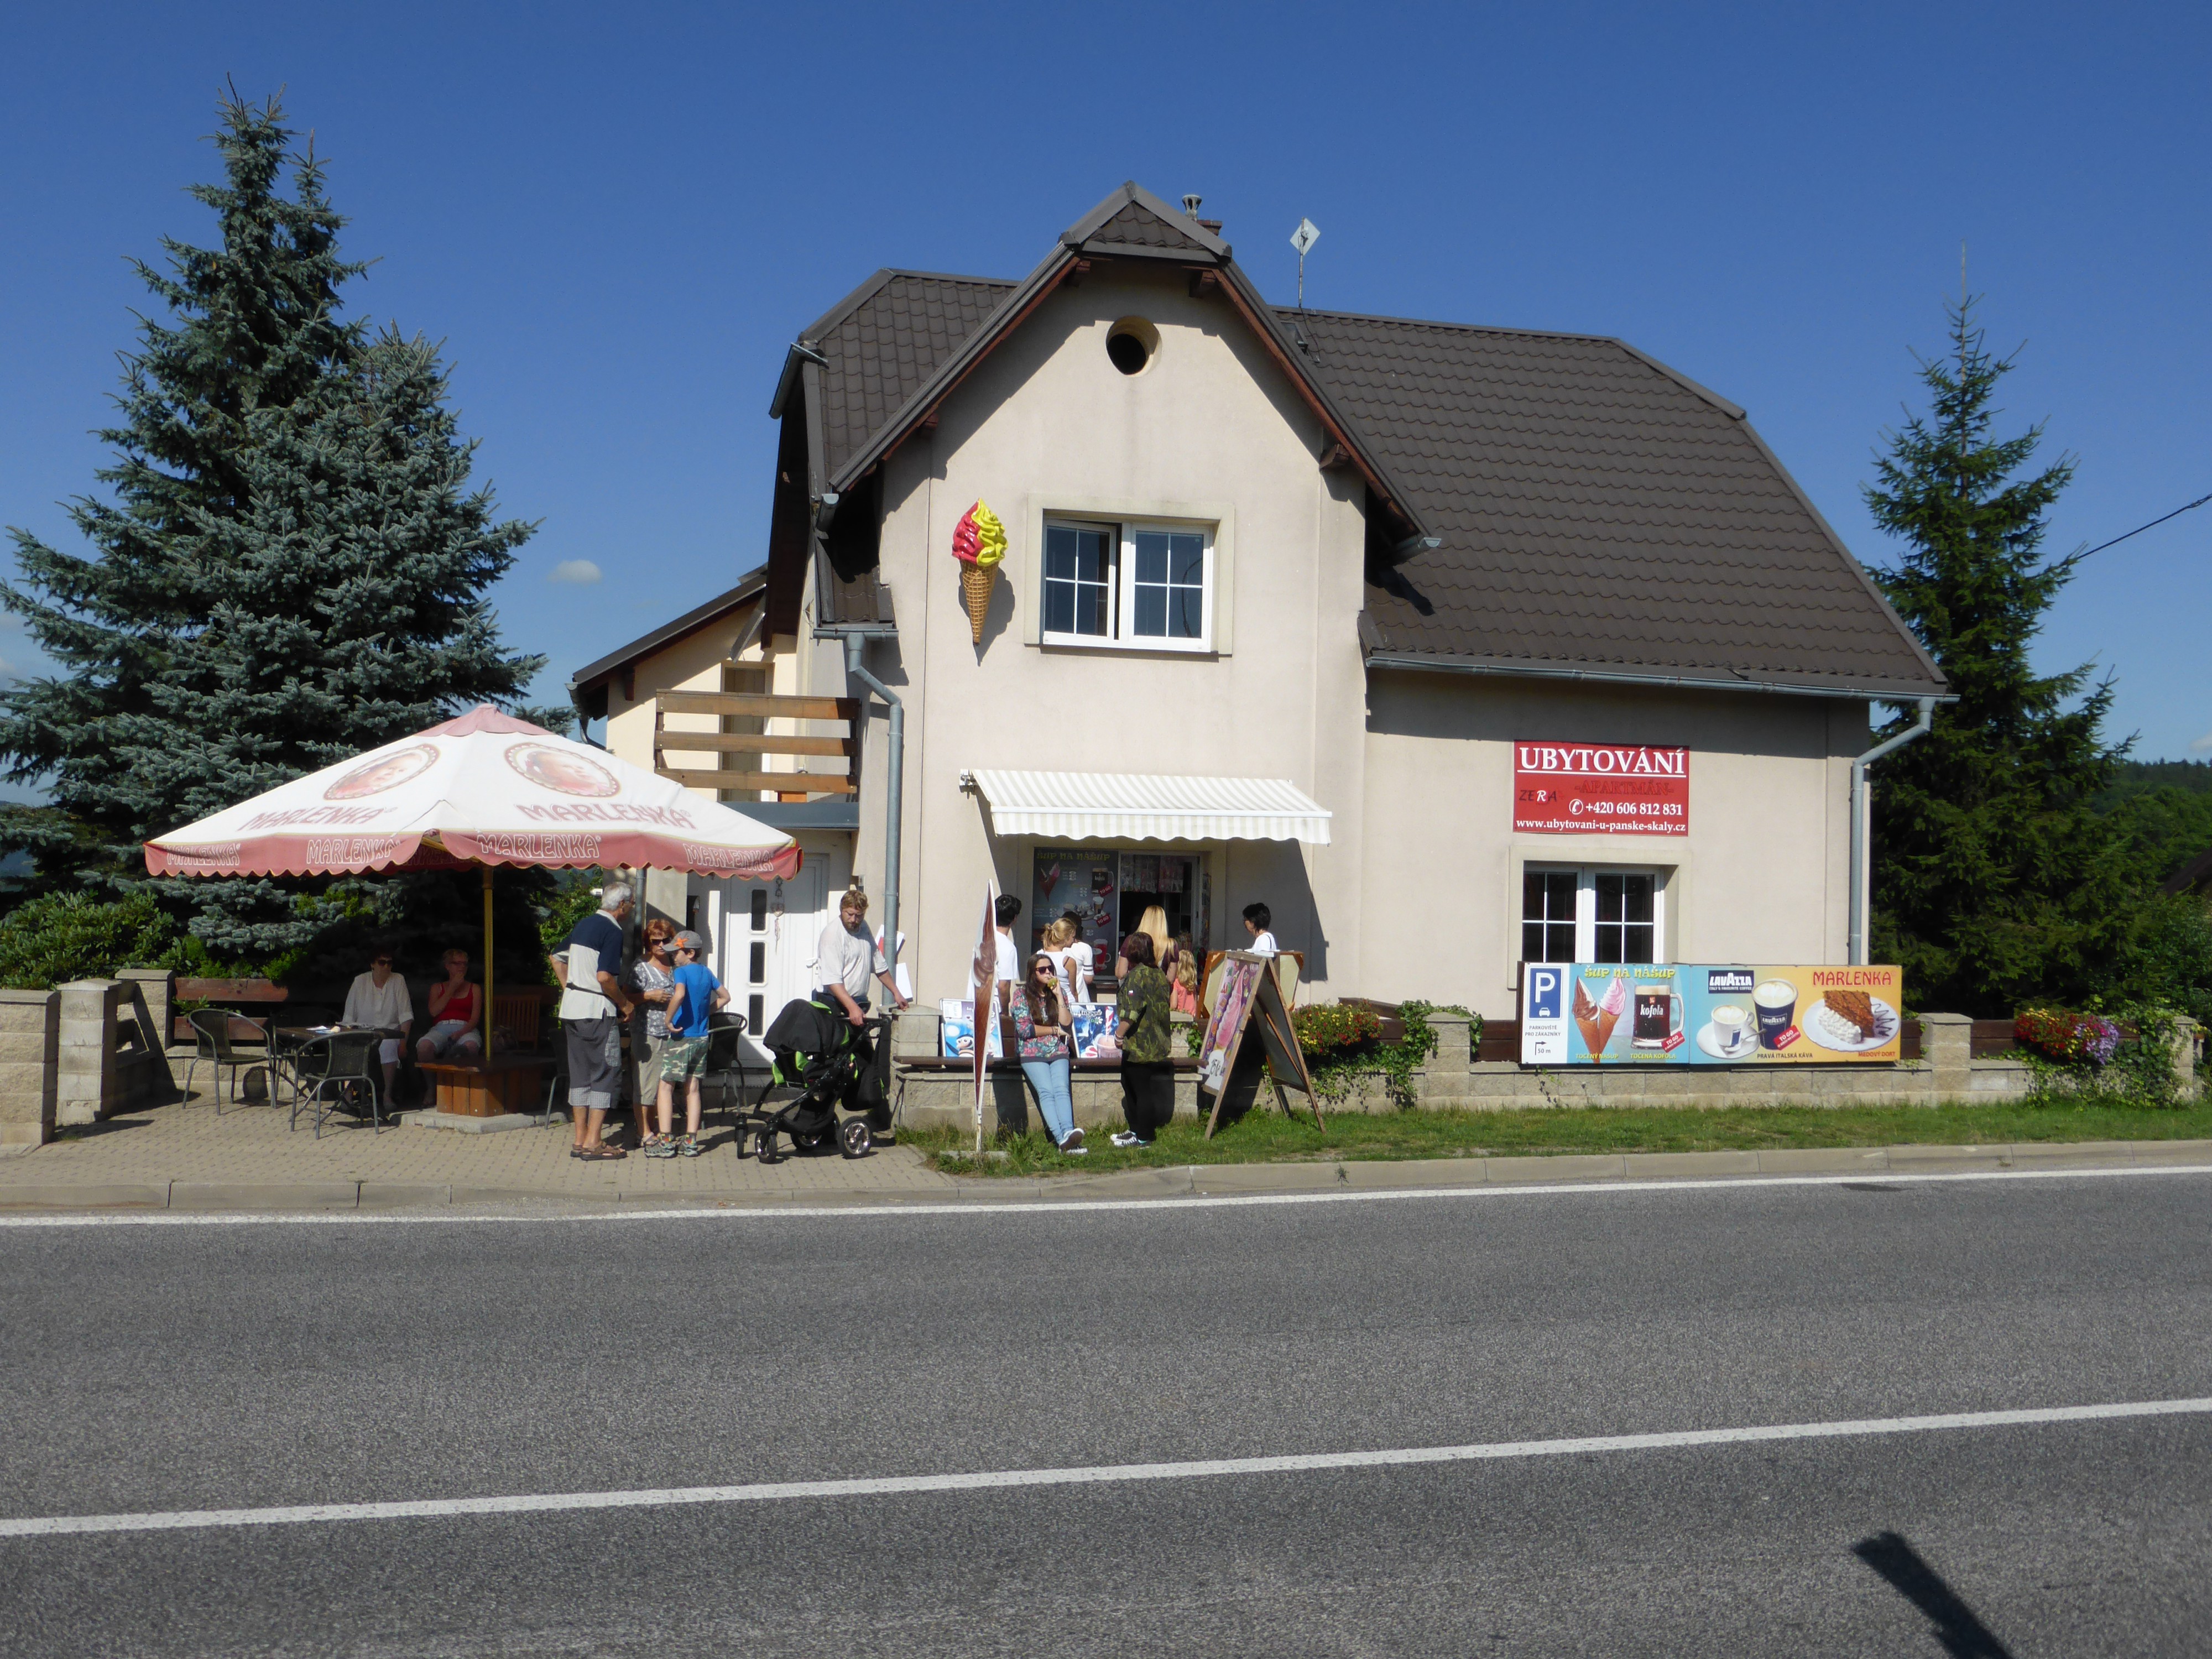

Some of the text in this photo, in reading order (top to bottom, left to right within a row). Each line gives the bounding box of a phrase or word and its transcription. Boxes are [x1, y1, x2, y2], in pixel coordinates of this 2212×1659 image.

[1519, 746, 1684, 774] UBYTOVÁNÍ
[514, 803, 698, 830] MARLENKA
[1585, 802, 1682, 816] +420 606 812 831
[237, 806, 385, 832] MARLENKA
[1516, 818, 1686, 833] www.ubytovani-u-panske-skaly.cz
[477, 834, 600, 858] MARLENKA
[682, 843, 774, 872] MARLENKA
[1584, 965, 1676, 979] ŠUP NA NÁŠUP
[1709, 972, 1752, 986] LAVAZZA
[1813, 971, 1892, 985] MARLENKA
[1535, 972, 1555, 1003] P
[1640, 1004, 1664, 1018] kofola
